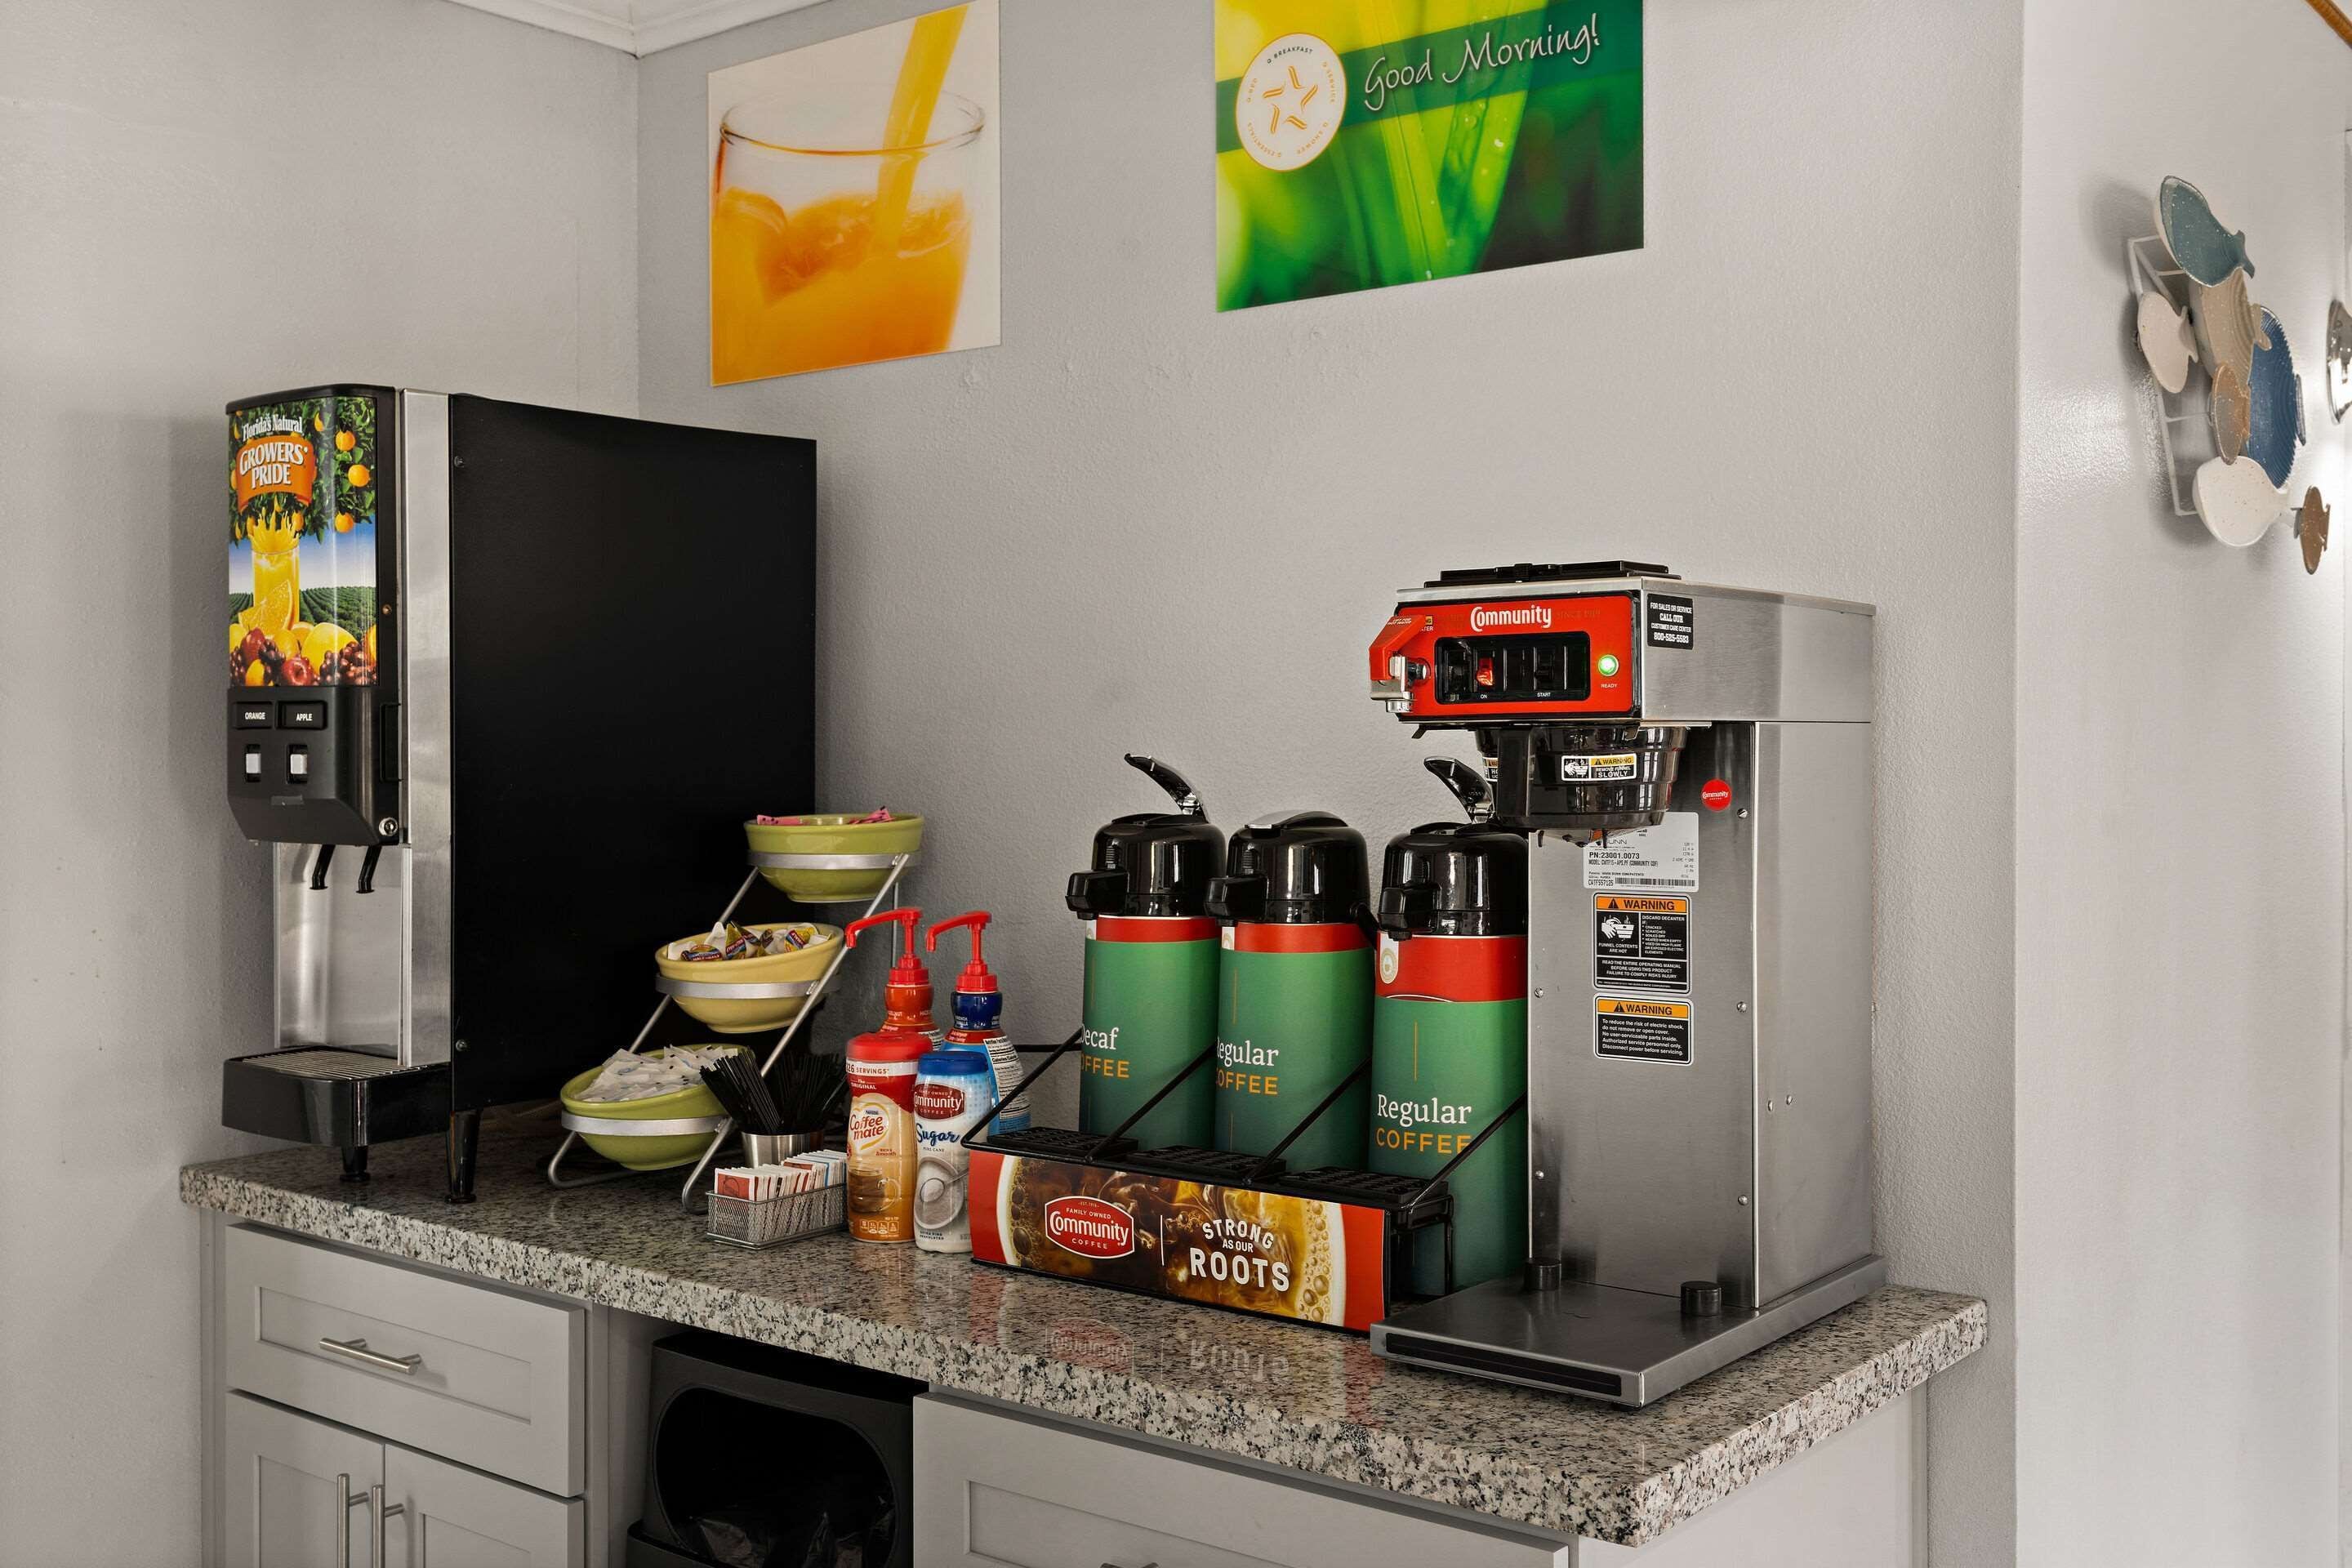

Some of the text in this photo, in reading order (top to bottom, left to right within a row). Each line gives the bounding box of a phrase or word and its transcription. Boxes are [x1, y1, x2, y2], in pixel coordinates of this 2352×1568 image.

[1274, 46, 1313, 58] BREAKFAST
[1364, 12, 1601, 111] Good Morning!
[243, 413, 303, 442] Florida's Natural
[252, 463, 292, 489] PRIDE
[1677, 605, 1692, 613] SERVICE
[1470, 604, 1552, 632] Community
[1659, 612, 1683, 622] CALL OUR
[245, 711, 265, 719] ORANGE
[296, 713, 313, 721] APPLE
[1603, 757, 1632, 765] WARNING
[1598, 770, 1628, 778] SLOWLY
[1624, 899, 1675, 911] WARNING
[1626, 1004, 1673, 1015] WARNING
[1081, 1053, 1129, 1078] FFEE
[1216, 1067, 1279, 1095] OFFEE
[1377, 1094, 1472, 1128] Regular
[849, 1114, 883, 1132] Coffee
[853, 1125, 884, 1140] mate
[915, 1122, 960, 1147] Sugar
[1066, 1207, 1111, 1219] FAMILY OWNED
[1049, 1210, 1129, 1246] Community
[1202, 1218, 1274, 1249] STRONG
[1071, 1238, 1108, 1250] COFFEE
[1222, 1239, 1254, 1253] AS OUR
[1190, 1247, 1290, 1292] ROOTS
